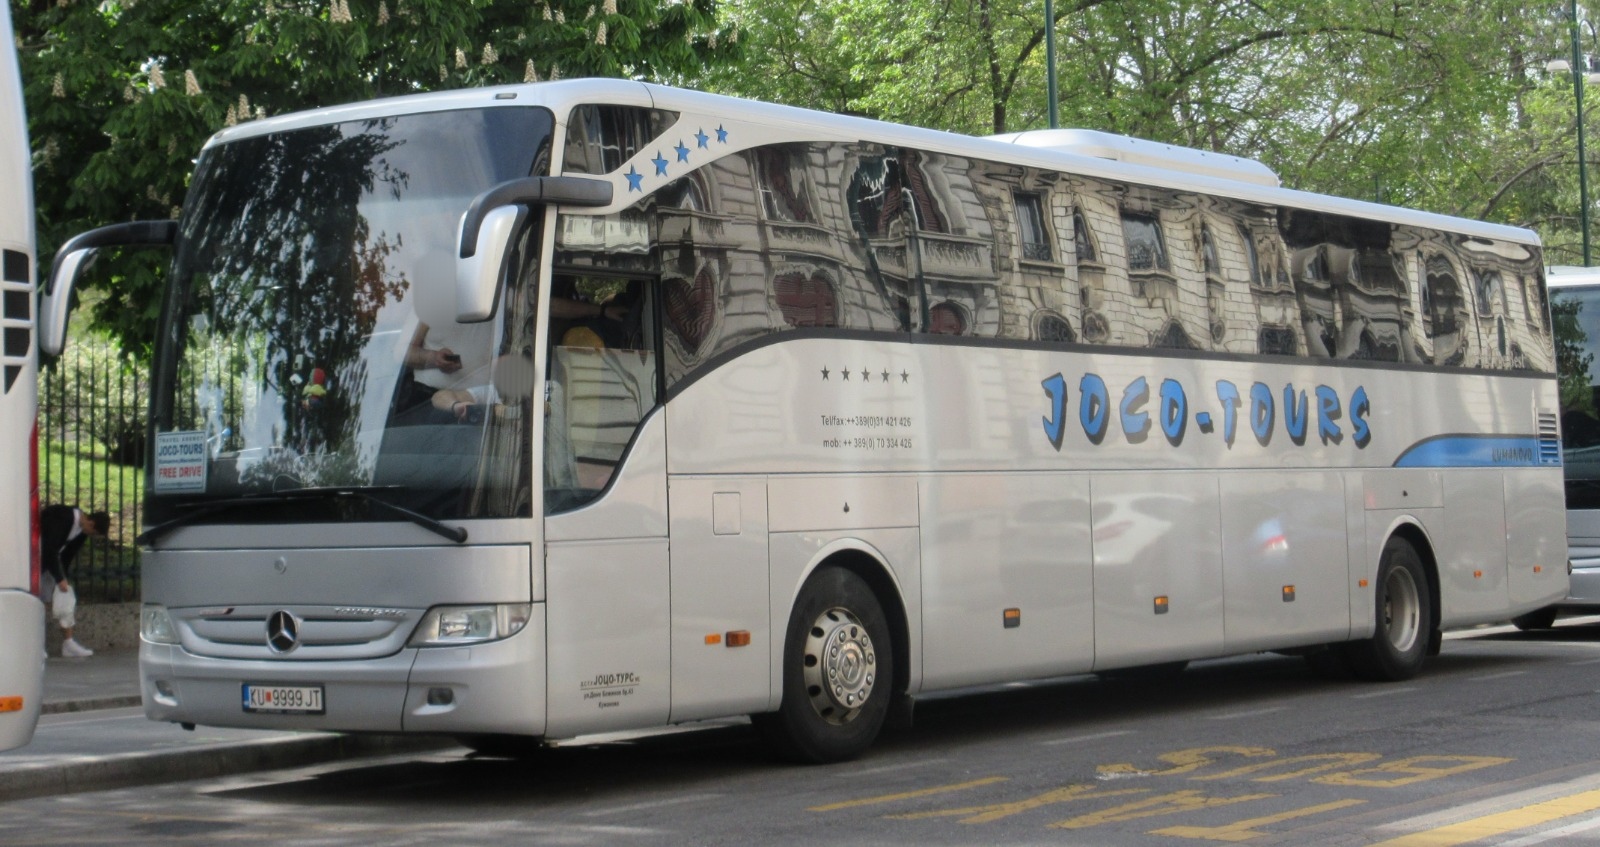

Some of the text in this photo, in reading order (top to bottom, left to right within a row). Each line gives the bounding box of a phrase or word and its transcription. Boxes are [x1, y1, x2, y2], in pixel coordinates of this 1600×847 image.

[1041, 372, 1372, 453] JOCO-TOURS
[885, 416, 898, 428] 421
[899, 417, 912, 428] 426
[823, 437, 841, 449] mob:
[876, 438, 885, 449] 70
[886, 438, 899, 449] 334
[900, 438, 912, 449] 426
[158, 444, 203, 456] JOCO-TOURS
[159, 466, 202, 478] FREE DRIVE
[250, 688, 320, 708] KU 9999 JT
